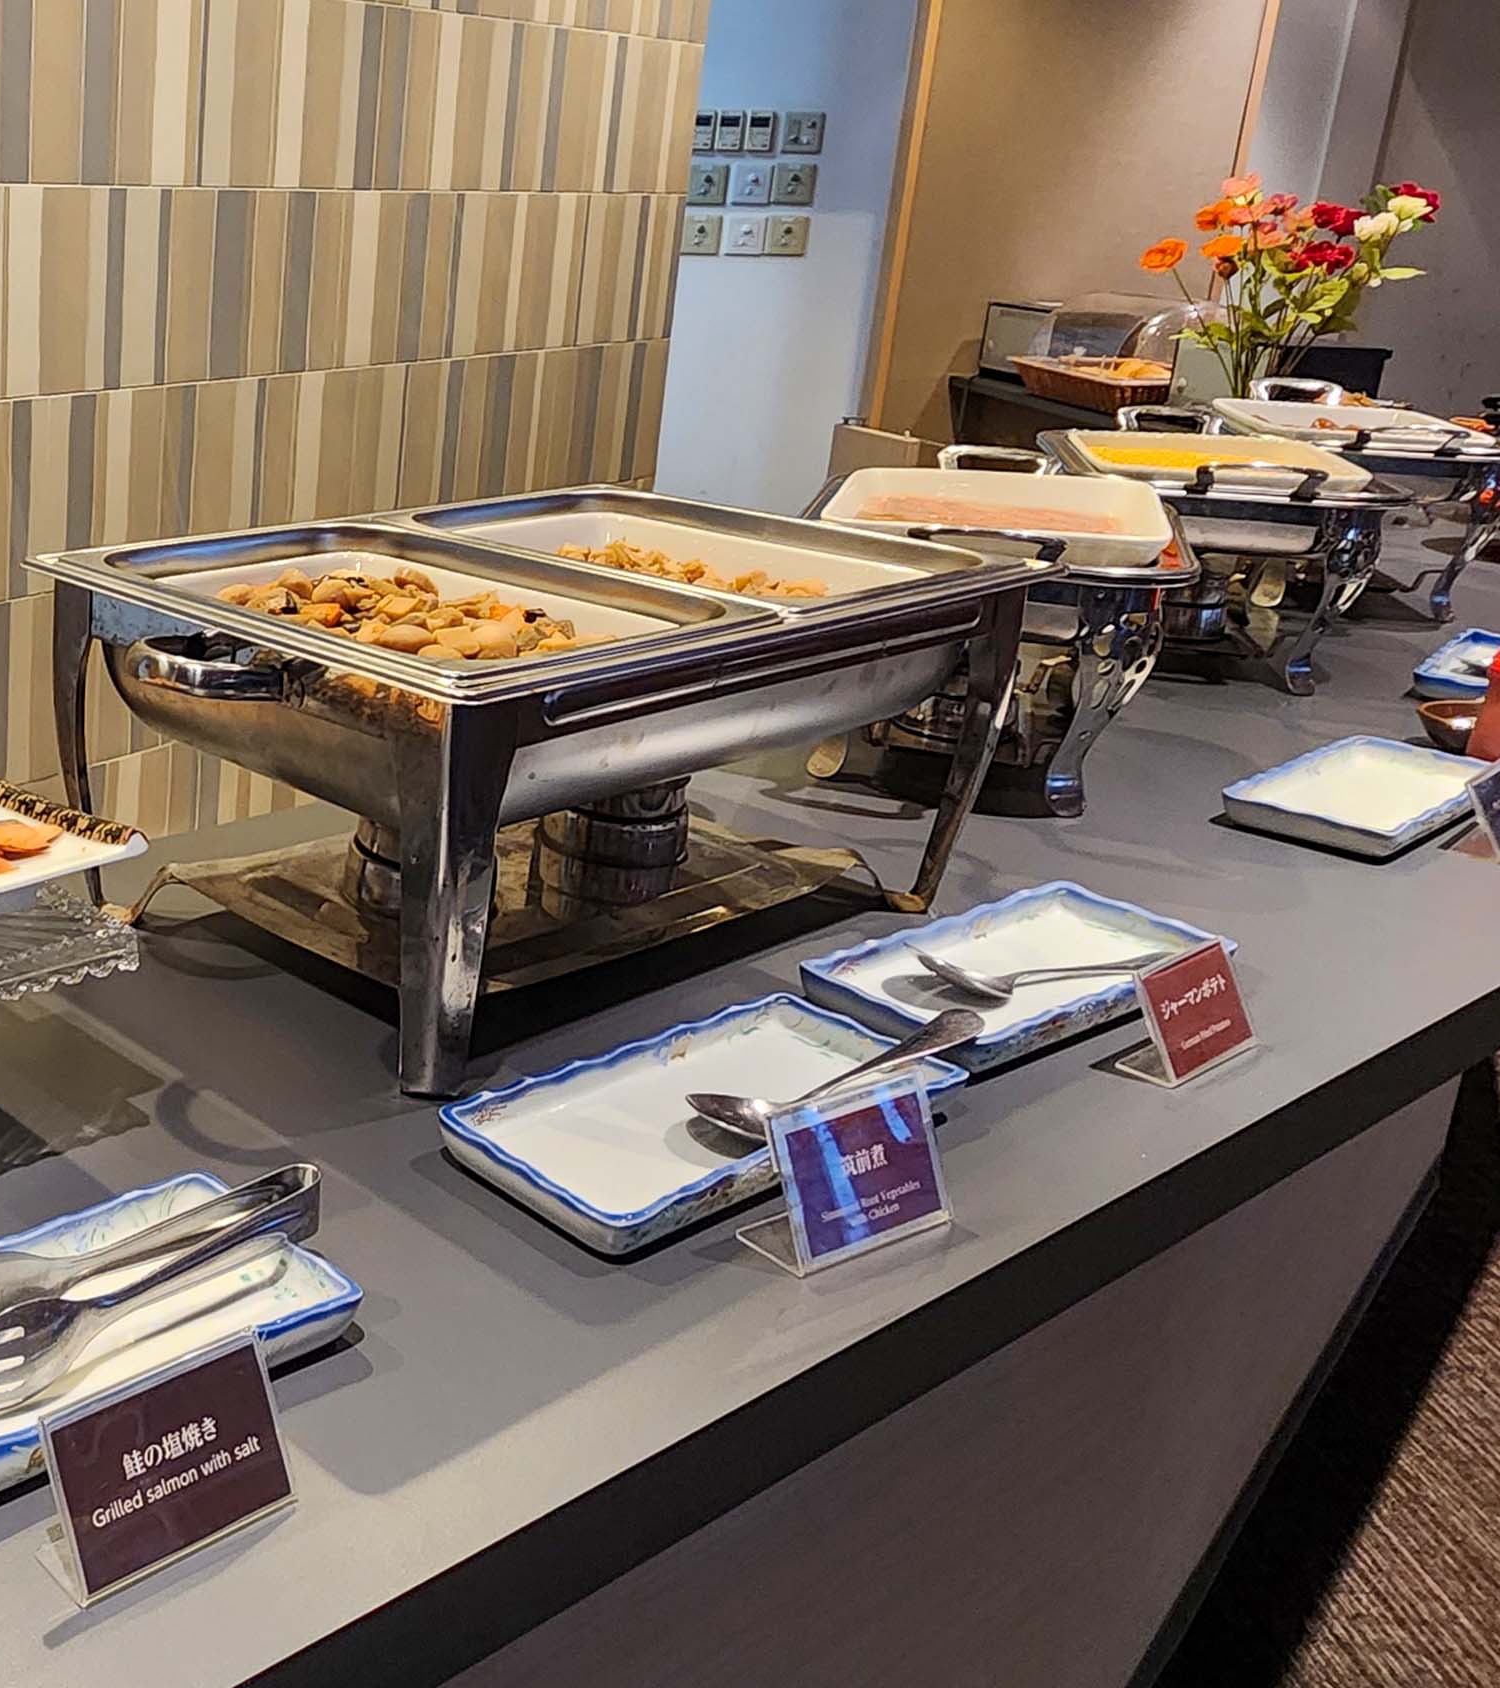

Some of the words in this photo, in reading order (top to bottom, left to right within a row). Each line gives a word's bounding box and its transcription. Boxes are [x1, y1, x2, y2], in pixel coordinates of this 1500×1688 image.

[1160, 973, 1226, 1020] ジャーマンポテト
[122, 1416, 218, 1481] 鮭の塩焼き
[91, 1490, 144, 1528] Grilled
[146, 1467, 199, 1504] salmon
[199, 1449, 232, 1477] with
[235, 1436, 262, 1462] salt
